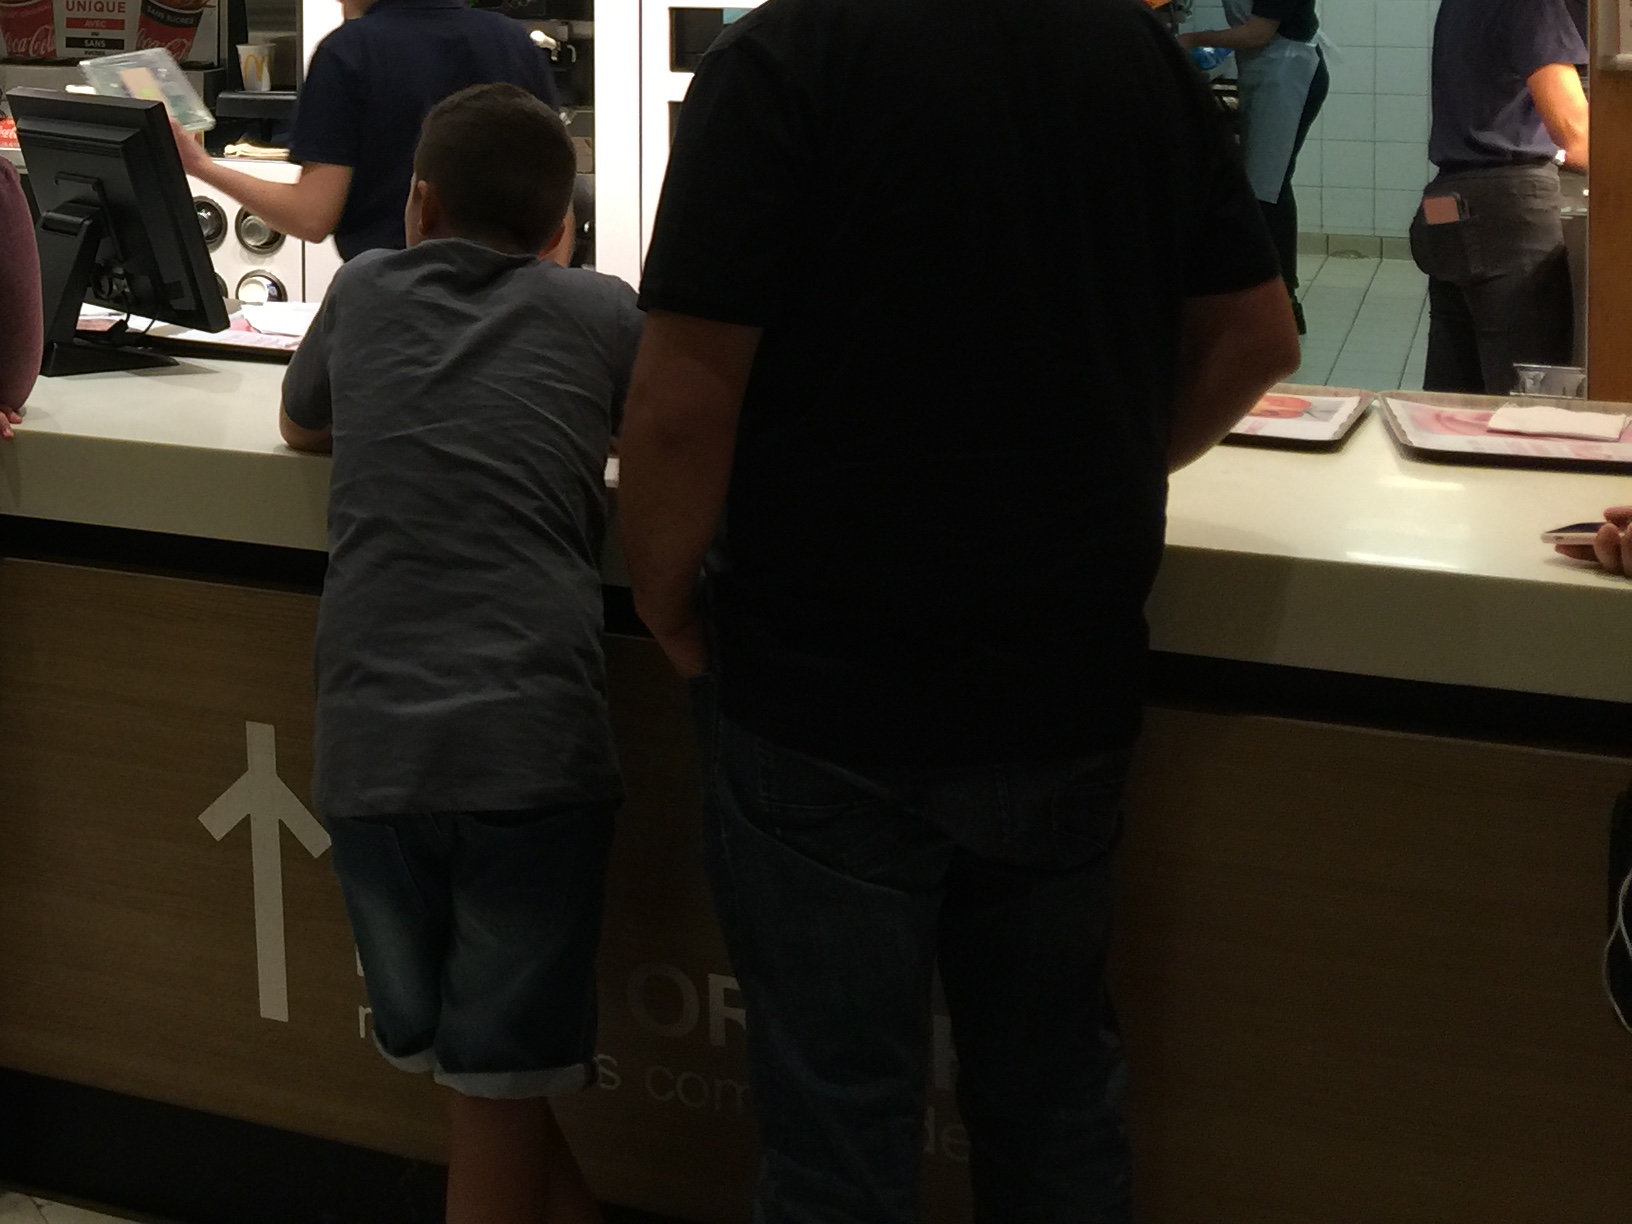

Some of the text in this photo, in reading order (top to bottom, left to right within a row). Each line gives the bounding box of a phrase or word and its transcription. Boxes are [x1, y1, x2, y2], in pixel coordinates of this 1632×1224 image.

[66, 0, 126, 13] UNIQUE
[84, 20, 107, 28] AVEC
[84, 39, 106, 48] SANS
